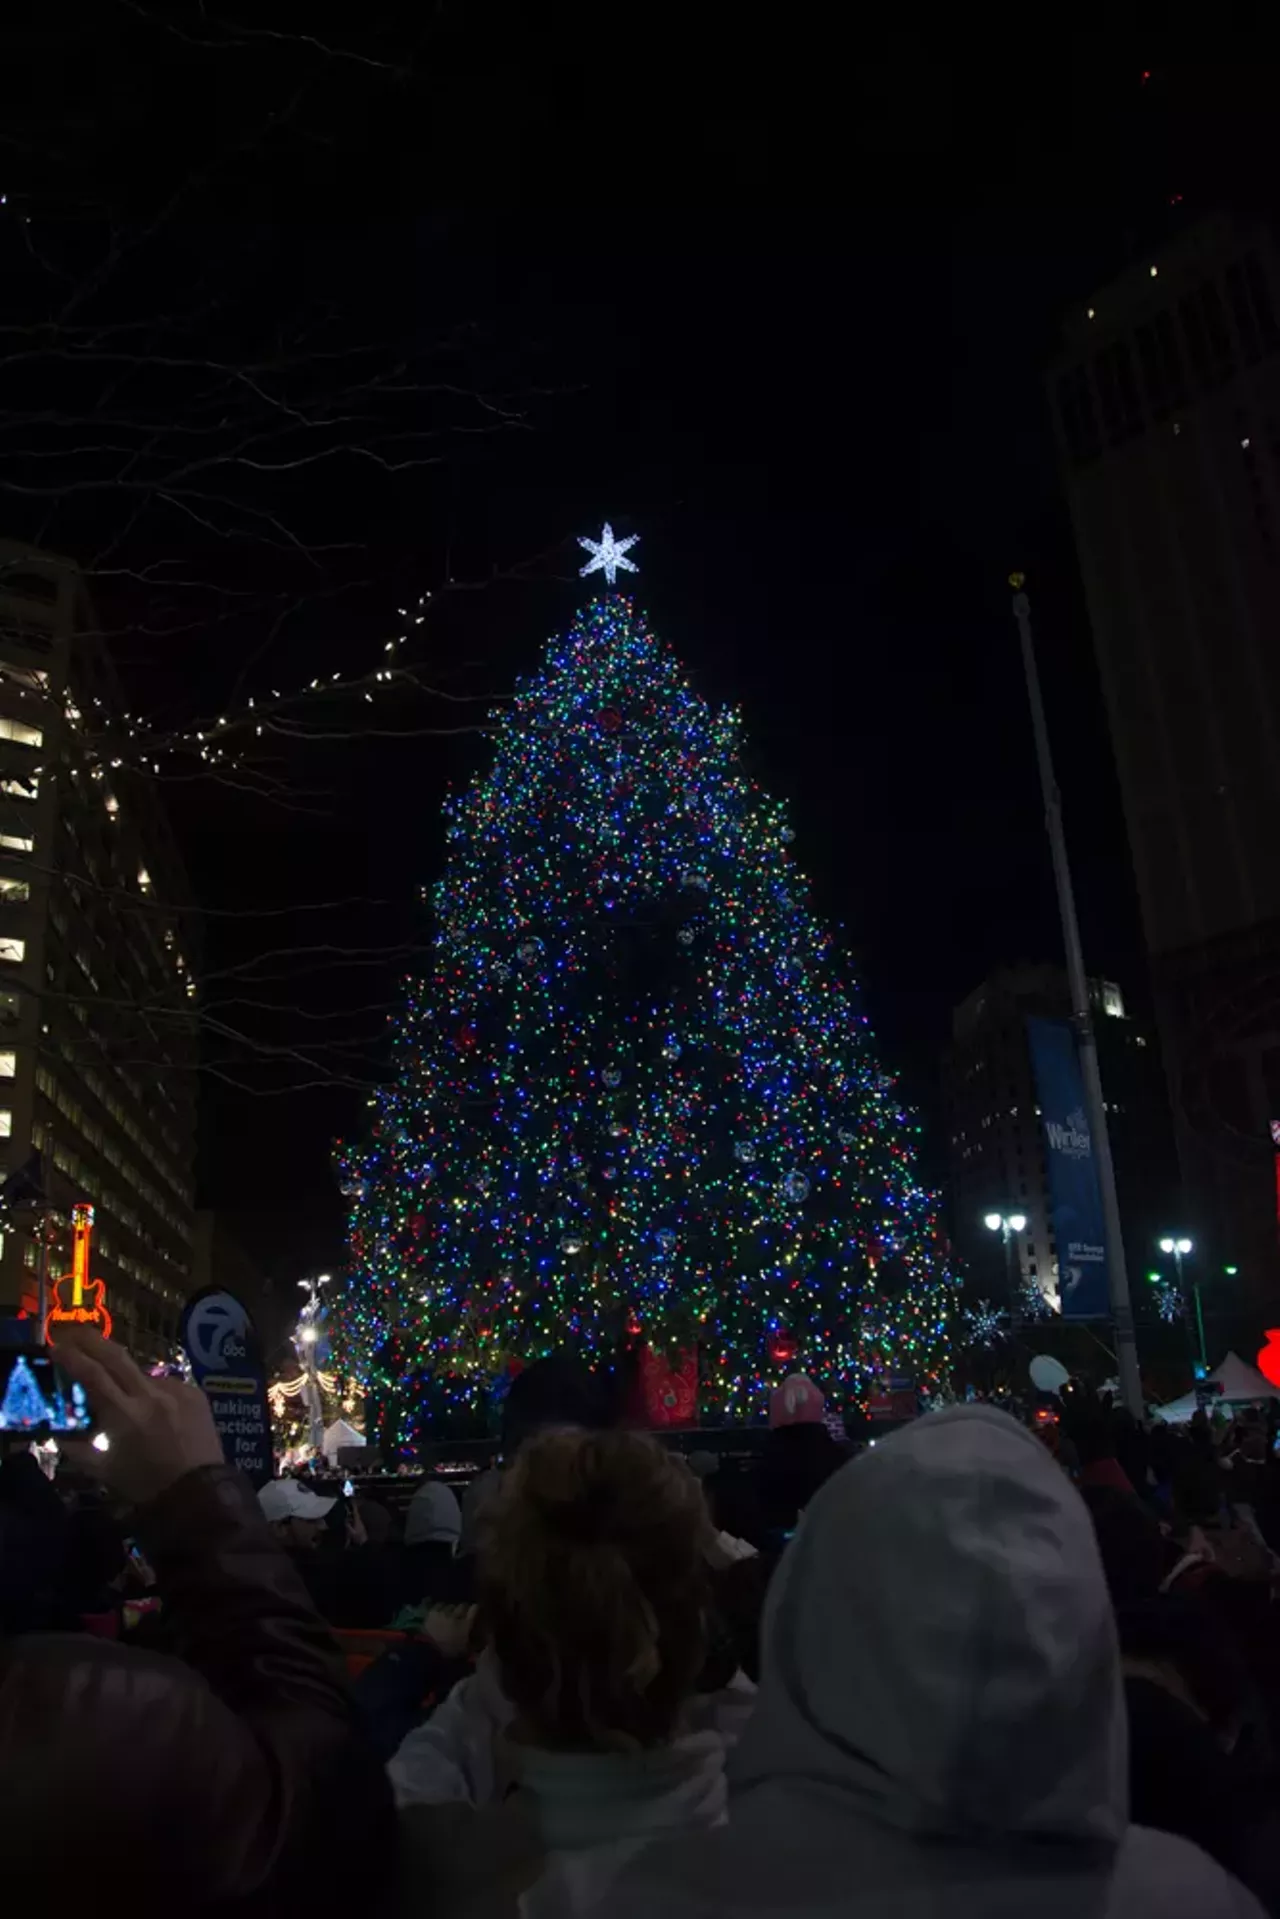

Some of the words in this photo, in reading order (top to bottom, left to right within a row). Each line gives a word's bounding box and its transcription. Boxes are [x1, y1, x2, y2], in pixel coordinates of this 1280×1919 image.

[223, 1343, 246, 1357] abc
[212, 1400, 261, 1419] taking
[216, 1418, 264, 1434] action
[235, 1437, 258, 1453] for
[234, 1456, 263, 1473] you
